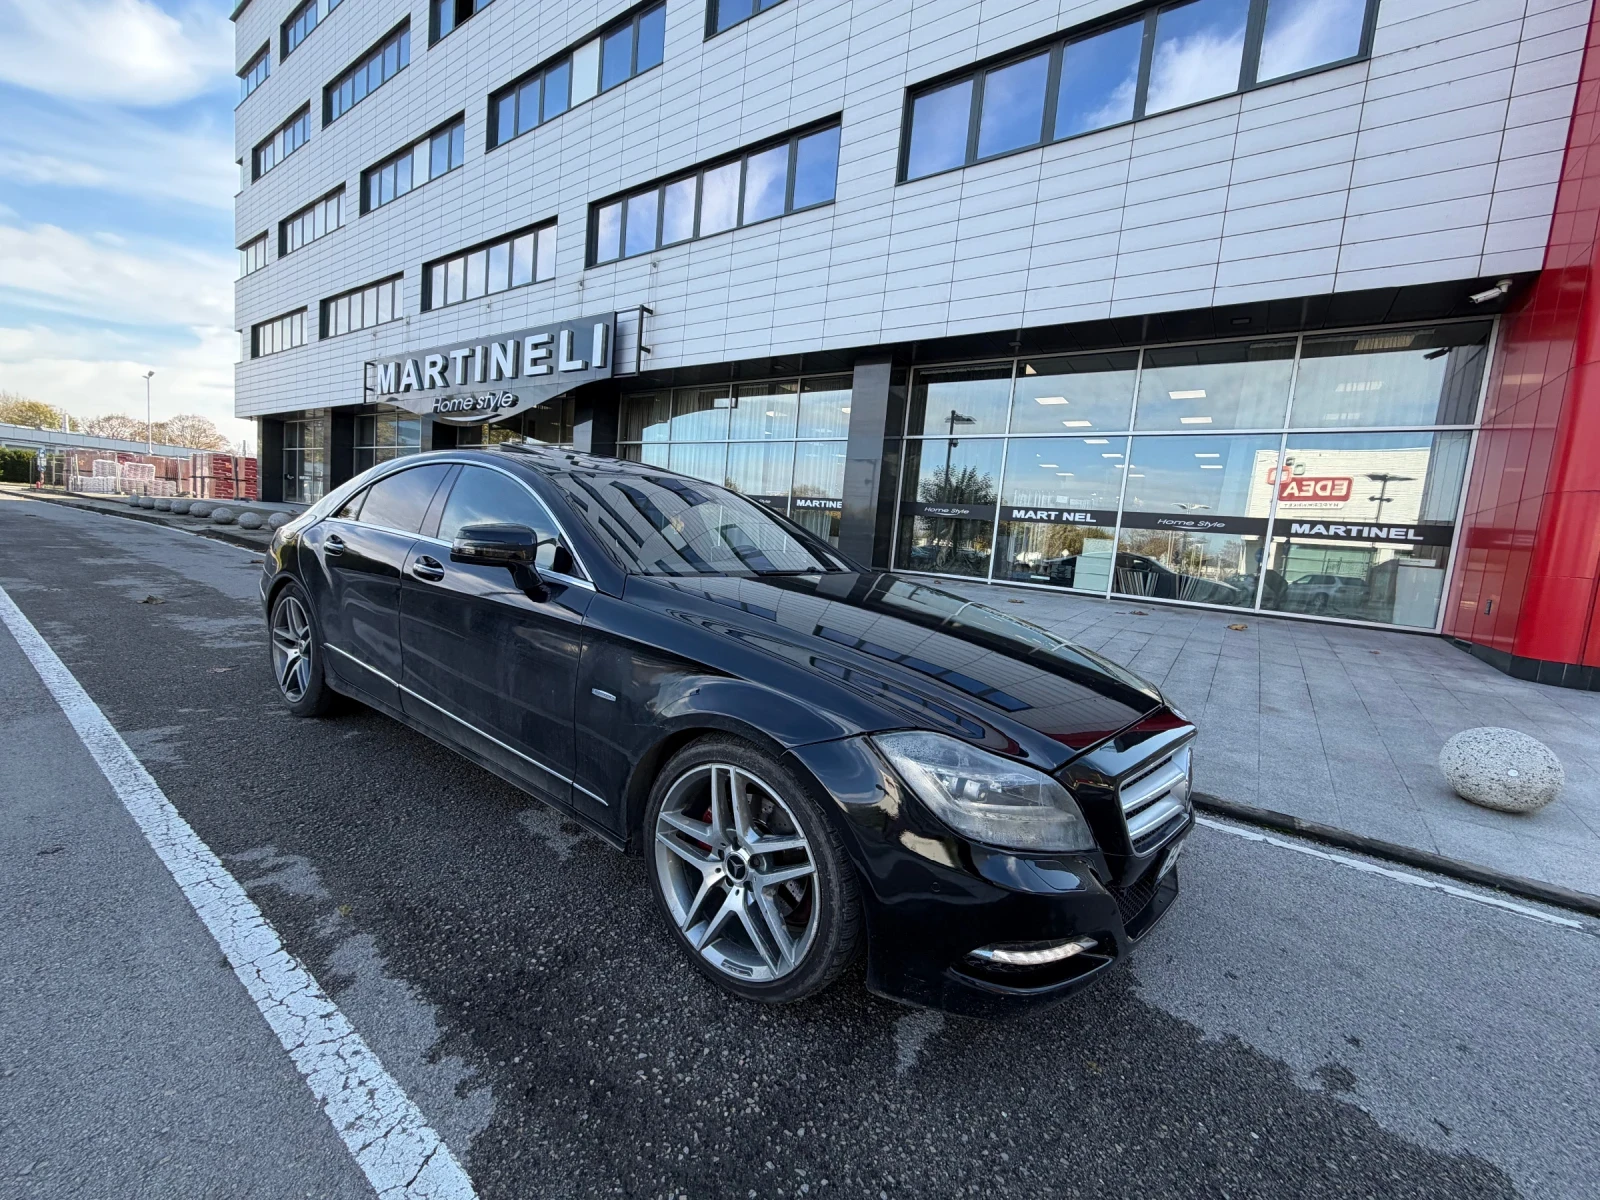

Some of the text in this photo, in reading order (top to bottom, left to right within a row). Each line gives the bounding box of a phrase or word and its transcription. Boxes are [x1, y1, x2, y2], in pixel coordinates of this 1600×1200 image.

[376, 322, 609, 395] MARTINELI
[432, 390, 513, 412] Home style
[796, 499, 842, 509] MARTINE
[1157, 518, 1226, 528] Home Style
[1290, 523, 1424, 540] MARTINEL
